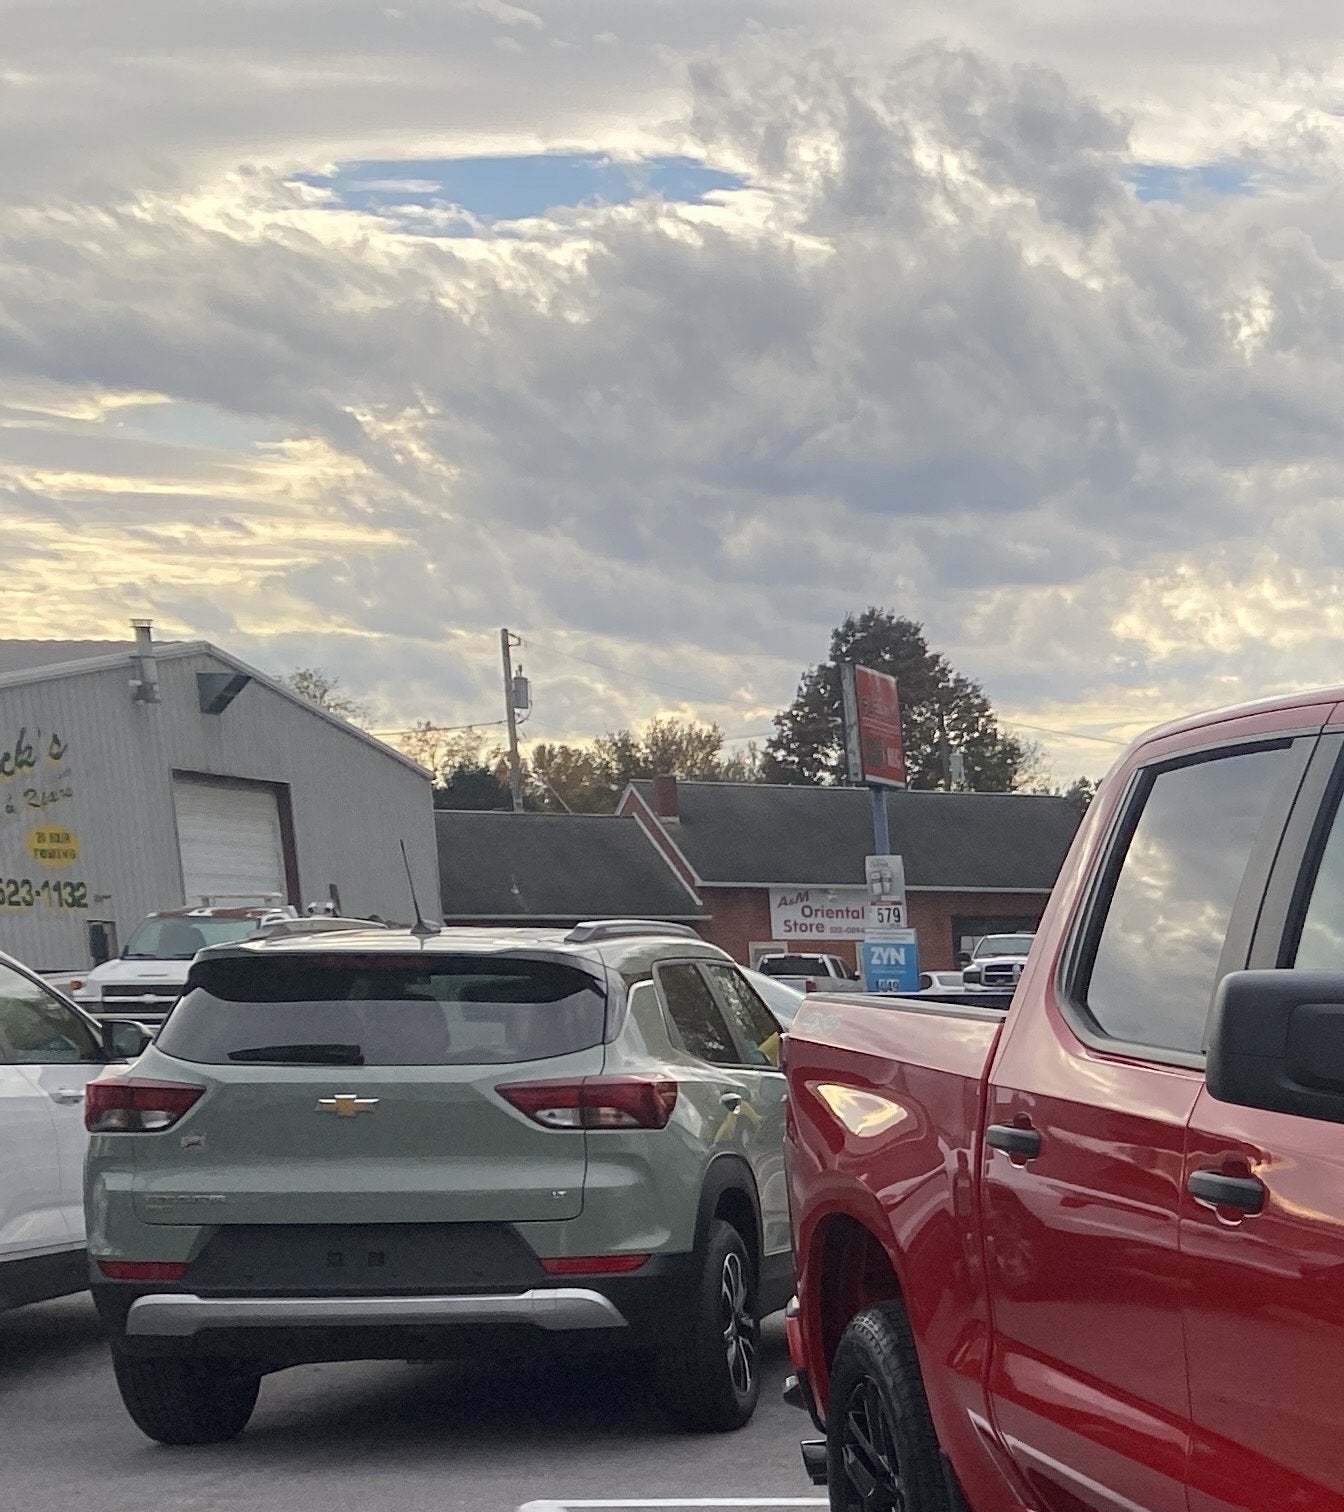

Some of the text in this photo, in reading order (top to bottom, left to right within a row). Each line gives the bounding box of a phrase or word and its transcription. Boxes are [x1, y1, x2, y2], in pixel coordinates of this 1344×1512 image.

[801, 904, 865, 920] Oriental
[877, 907, 901, 923] 579
[783, 919, 825, 933] Store
[871, 946, 906, 966] ZYN
